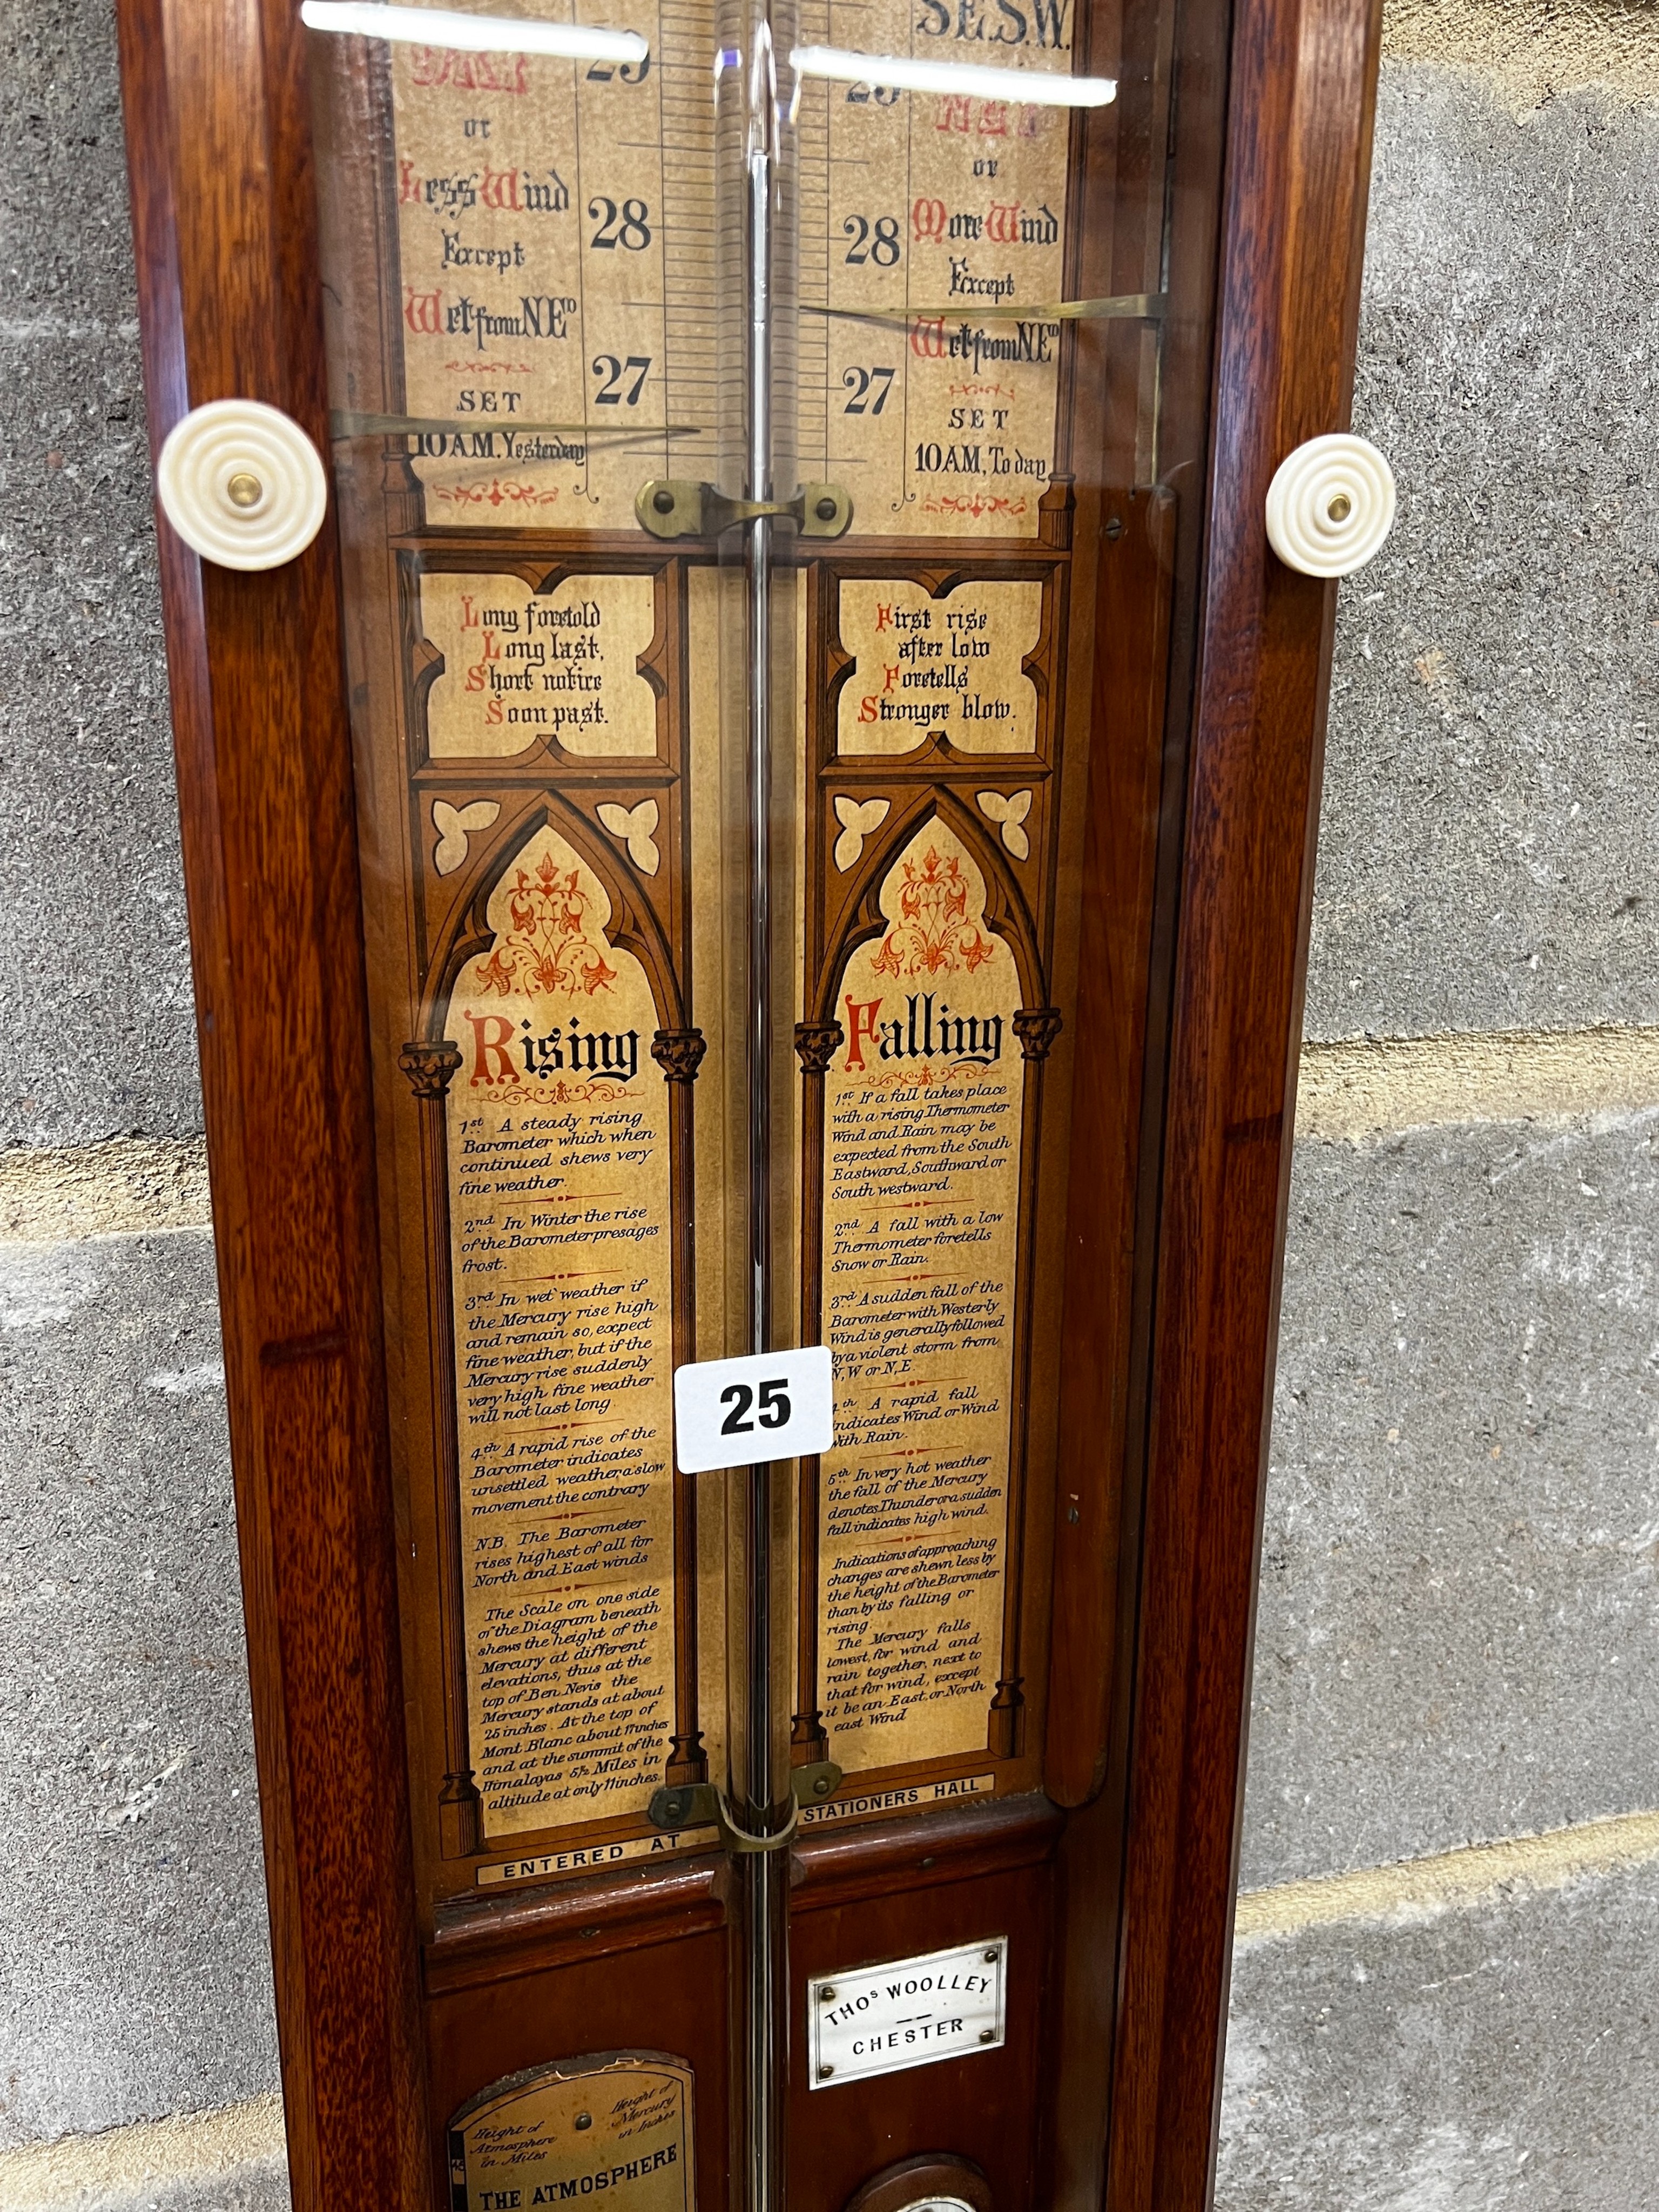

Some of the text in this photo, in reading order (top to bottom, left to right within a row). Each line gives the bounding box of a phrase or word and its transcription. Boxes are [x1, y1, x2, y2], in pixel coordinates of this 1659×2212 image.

[463, 119, 490, 139] or
[973, 159, 997, 179] or
[398, 159, 569, 220] Less Wind
[588, 197, 652, 251] 28
[913, 199, 1058, 245] More Wind
[441, 230, 525, 275] Except
[844, 214, 900, 266] 28
[949, 257, 1015, 304] Except
[592, 355, 652, 406] 27
[843, 366, 895, 415] 27
[457, 392, 520, 412] SET
[948, 408, 1009, 430] SET
[502, 431, 585, 466] Yesterday
[461, 596, 601, 635] Long foretold
[875, 603, 987, 635] First rise
[482, 631, 545, 666] Long
[899, 632, 990, 664] after low
[466, 664, 602, 698] Short notice
[882, 663, 968, 693] Foretells
[485, 698, 608, 732] Soon past.
[858, 694, 1016, 726] Stronger blow.
[464, 1010, 643, 1087] Rising
[845, 992, 1006, 1073] Falling
[859, 1091, 874, 1104] If
[876, 1094, 887, 1103] a
[891, 1088, 919, 1103] fall
[924, 1085, 962, 1099] takes
[965, 1084, 1007, 1101] place
[496, 1118, 514, 1132] A
[521, 1113, 582, 1132] steady
[589, 1110, 643, 1127] rising
[833, 1103, 1010, 1124] with a rising Thermometer
[460, 1128, 656, 1155] Barometer which when
[460, 1149, 654, 1174] continued shews very
[459, 1175, 567, 1196] fine weather.
[501, 1217, 526, 1230] In
[531, 1213, 582, 1227] Winter
[584, 1209, 610, 1223] the
[614, 1207, 647, 1220] rise
[832, 1228, 992, 1255] Thermometer foretells
[832, 1251, 928, 1272] Snow or Rain.
[496, 1293, 521, 1307] In
[560, 1283, 625, 1300] weather
[631, 1279, 649, 1293] if
[856, 1293, 869, 1306] A
[872, 1289, 927, 1304] sudden
[930, 1284, 958, 1298] fall
[961, 1282, 979, 1294] of
[980, 1280, 1003, 1293] the
[468, 1298, 659, 1331] the Mercury rise high
[468, 1398, 611, 1424] will not last long
[720, 1379, 791, 1436] 25
[853, 1470, 875, 1482] In
[874, 1467, 902, 1480] very
[906, 1462, 930, 1474] hot
[935, 1455, 991, 1470] weather
[828, 1473, 988, 1502] the fall of the Mercury
[517, 1532, 549, 1546] The
[555, 1519, 647, 1540] Barometer
[475, 1536, 653, 1570] rises highest of all for
[485, 1586, 660, 1622] The Scale on one side
[835, 1620, 971, 1651] The Mercury falls
[478, 1638, 648, 1675] Mercury at different
[827, 1689, 858, 1701] that
[861, 1683, 883, 1695] for
[934, 1667, 981, 1684] except
[834, 1708, 907, 1732] east Wind
[804, 1779, 979, 1822] STATIONERS HALL
[503, 1834, 680, 1878] ENTERED AT
[886, 1975, 992, 1999] WOOLLEY
[853, 2018, 963, 2055] CHESTER
[610, 2090, 656, 2115] Height
[528, 2121, 544, 2134] of
[470, 2136, 557, 2154] Atmosphere
[480, 2156, 497, 2168] in
[502, 2150, 548, 2164] Miles
[480, 2143, 677, 2211] THE ATMOSPHERE
